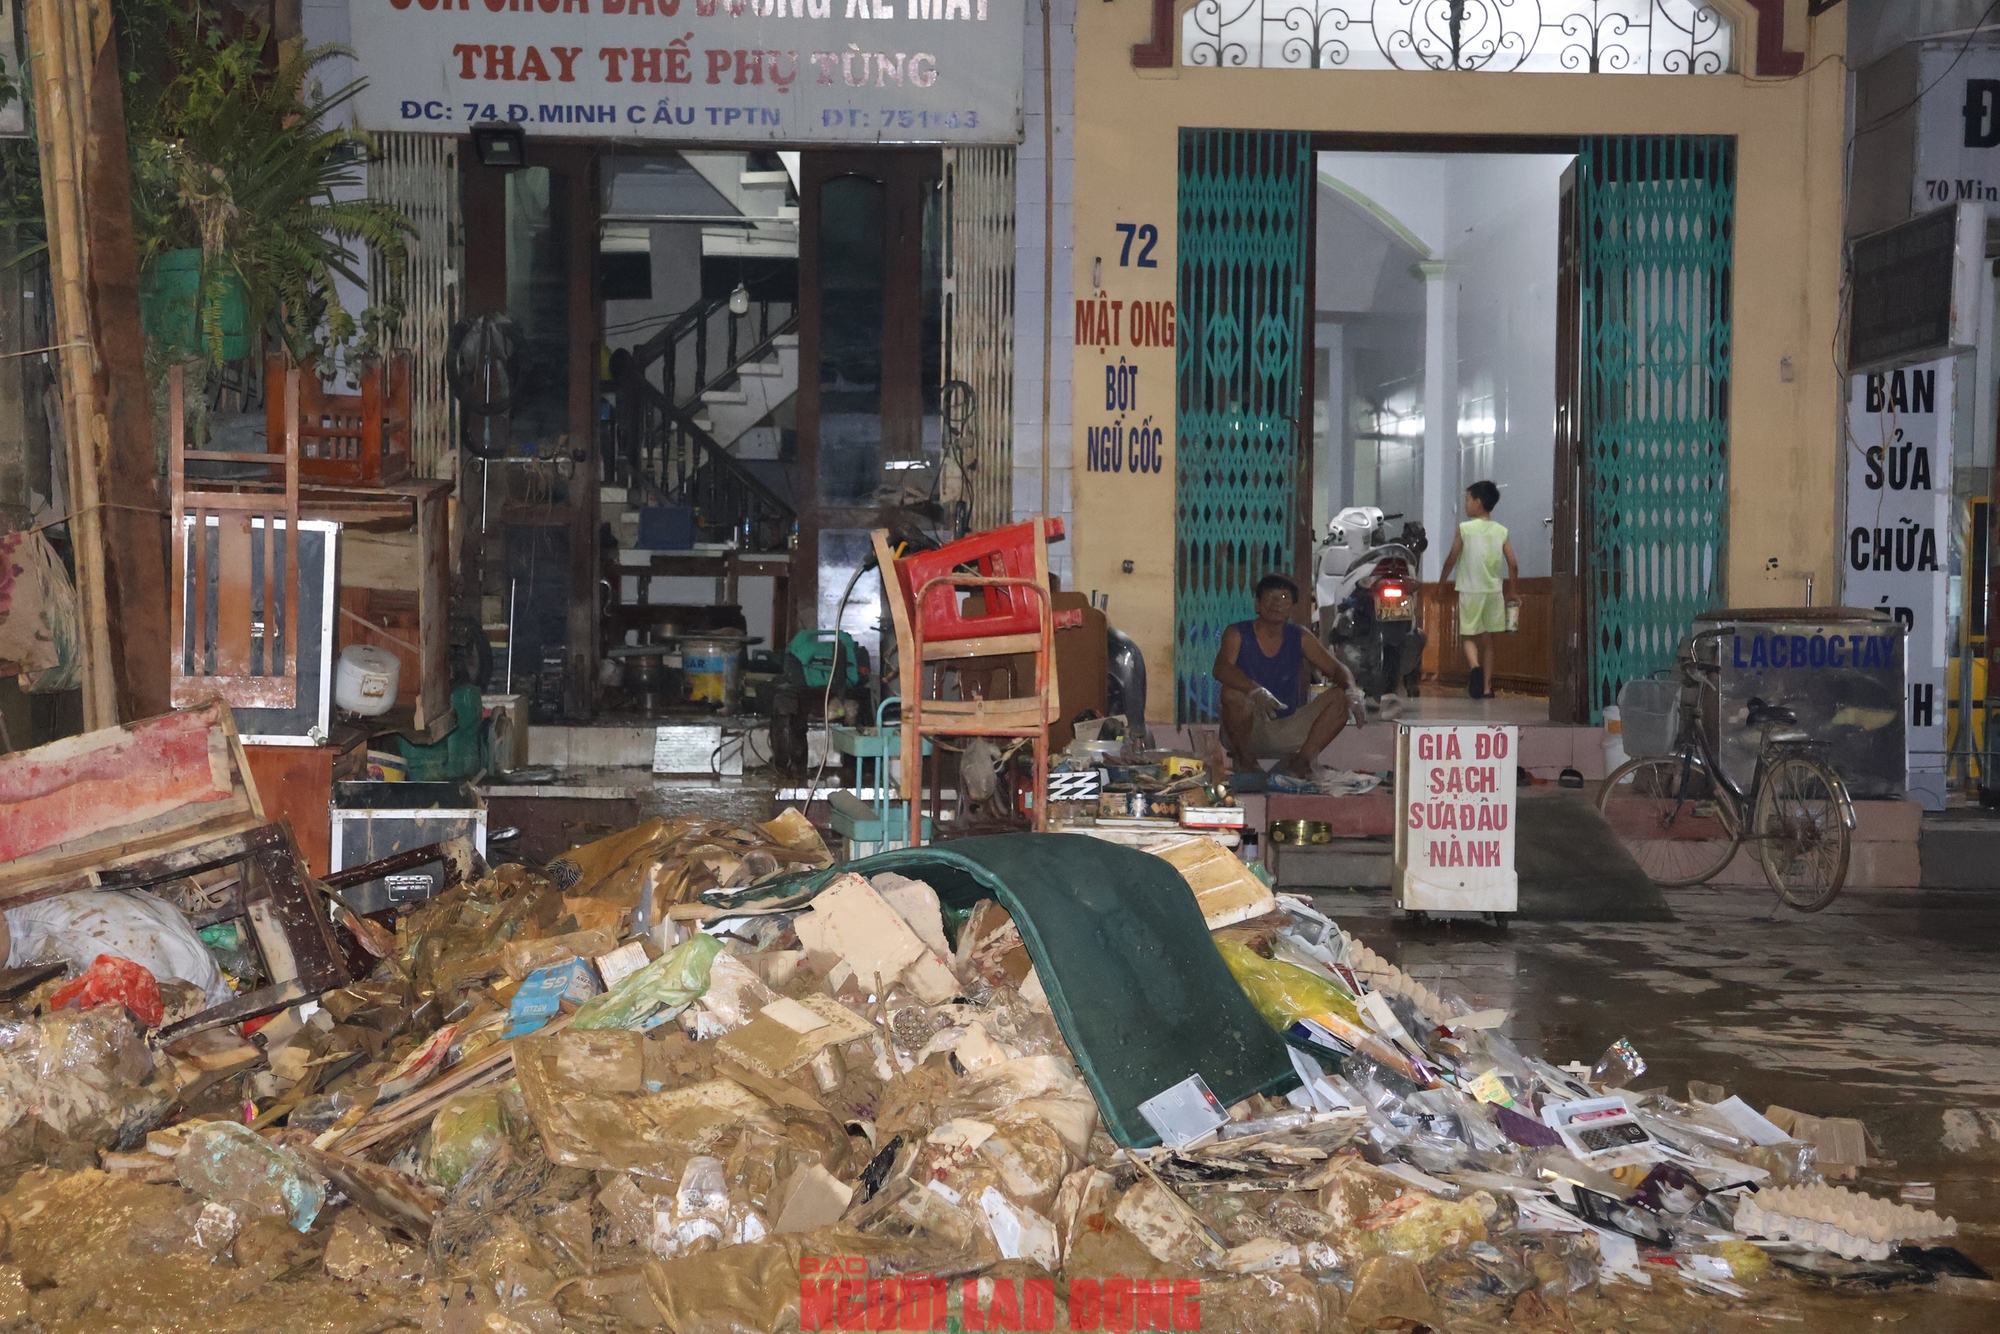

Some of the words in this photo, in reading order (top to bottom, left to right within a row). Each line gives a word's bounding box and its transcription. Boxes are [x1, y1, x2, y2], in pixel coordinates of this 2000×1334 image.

[452, 43, 583, 82] THAY
[599, 31, 693, 84] THẾ
[704, 49, 798, 94] PHỤ
[810, 42, 939, 88] TÙNG
[400, 100, 452, 120] ĐC:
[463, 103, 498, 121] 74
[705, 106, 780, 126] TPTN
[822, 108, 870, 128] ĐT:
[1926, 179, 1949, 201] 70
[1116, 223, 1158, 268] 72
[1075, 290, 1123, 355] MẬT
[1130, 300, 1175, 347] ONG
[1106, 355, 1138, 419] BỘT
[1087, 420, 1123, 473] NGŨ
[1128, 415, 1163, 474] CỐC
[1865, 428, 1932, 491] SỬA
[1850, 517, 1939, 572] CHỮA
[1418, 726, 1462, 761] GIÁ
[1429, 766, 1496, 800] SẠCH
[1429, 833, 1501, 868] NÀNH
